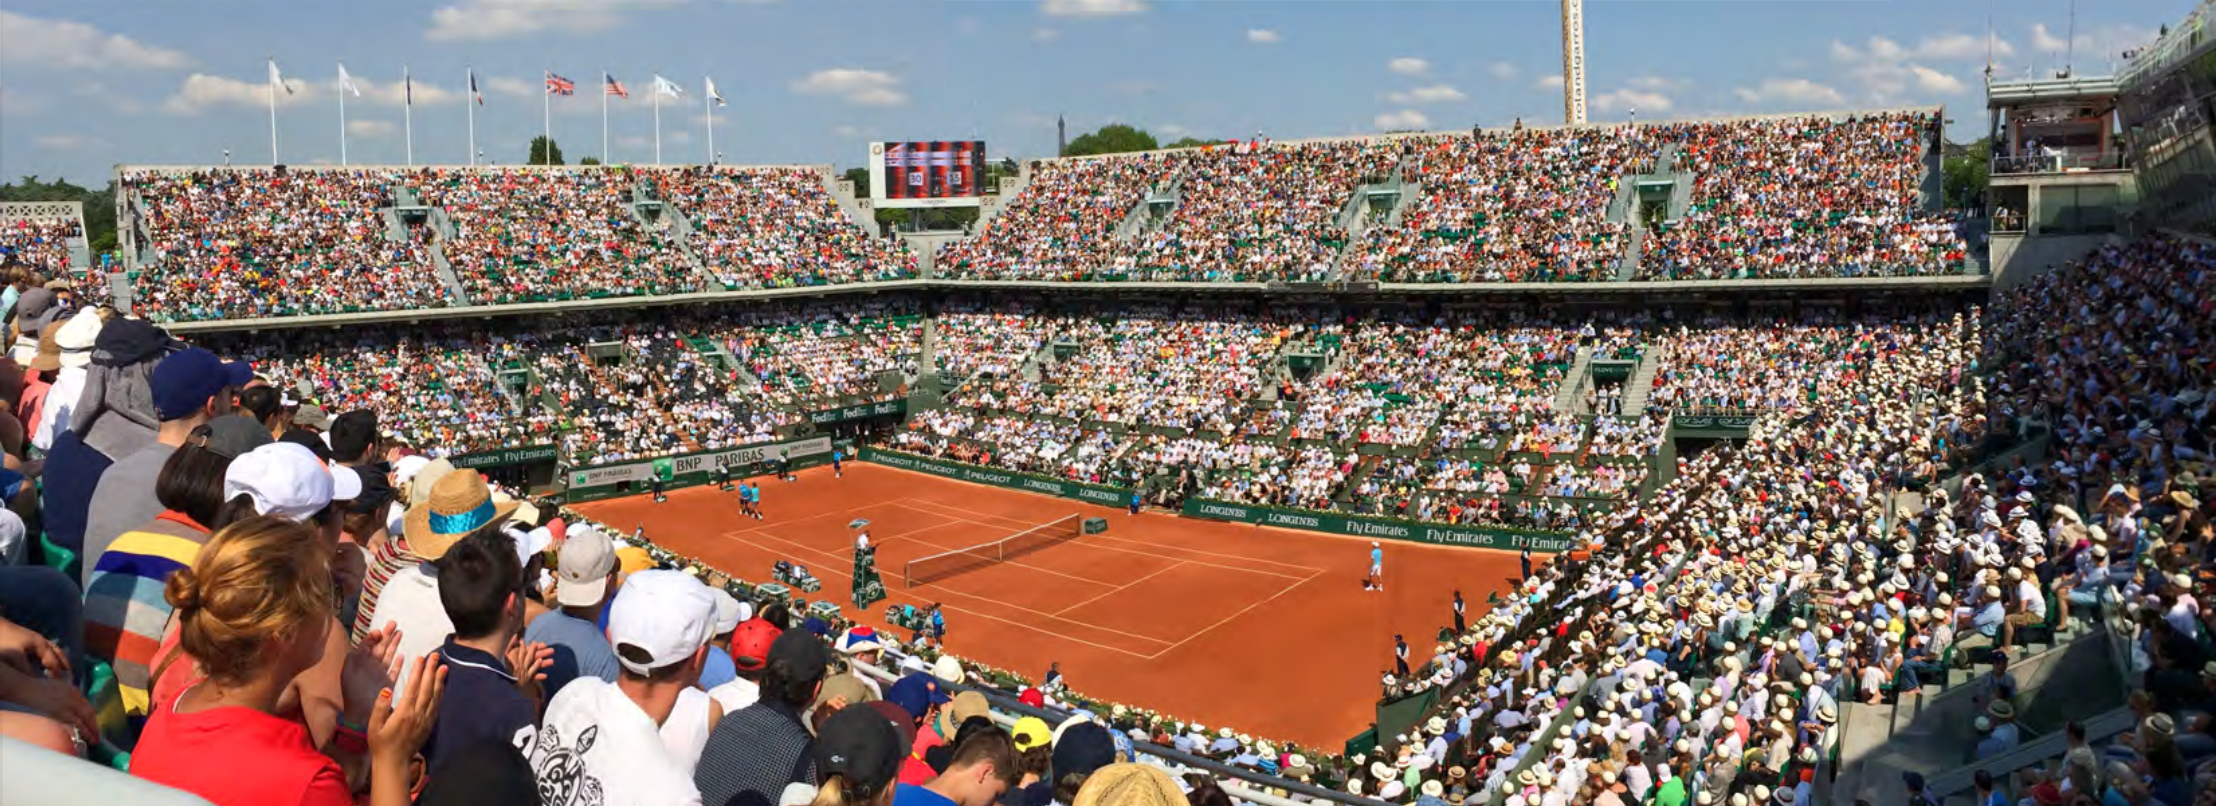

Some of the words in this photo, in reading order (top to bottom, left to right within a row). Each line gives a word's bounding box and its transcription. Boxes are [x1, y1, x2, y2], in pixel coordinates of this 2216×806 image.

[910, 174, 922, 183] 30
[463, 455, 500, 466] Emirates
[505, 451, 519, 462] Fly
[520, 448, 557, 460] Emirates
[676, 457, 702, 472] BNP
[715, 449, 765, 467] PARIBAS
[876, 454, 912, 466] PEUGEOT
[920, 462, 957, 475] PEUGEOT
[970, 471, 1011, 483] PEUGEOT
[1024, 479, 1061, 492] LONGINES
[1079, 489, 1119, 502] LONGINES
[1200, 504, 1246, 518] LONGINES
[1268, 513, 1319, 526] LONGINES
[1346, 520, 1363, 534] Fly
[1364, 522, 1409, 536] Emirates
[1426, 529, 1444, 543] Fly
[1446, 530, 1493, 544] Emirates
[1532, 537, 1569, 549] Emirat
